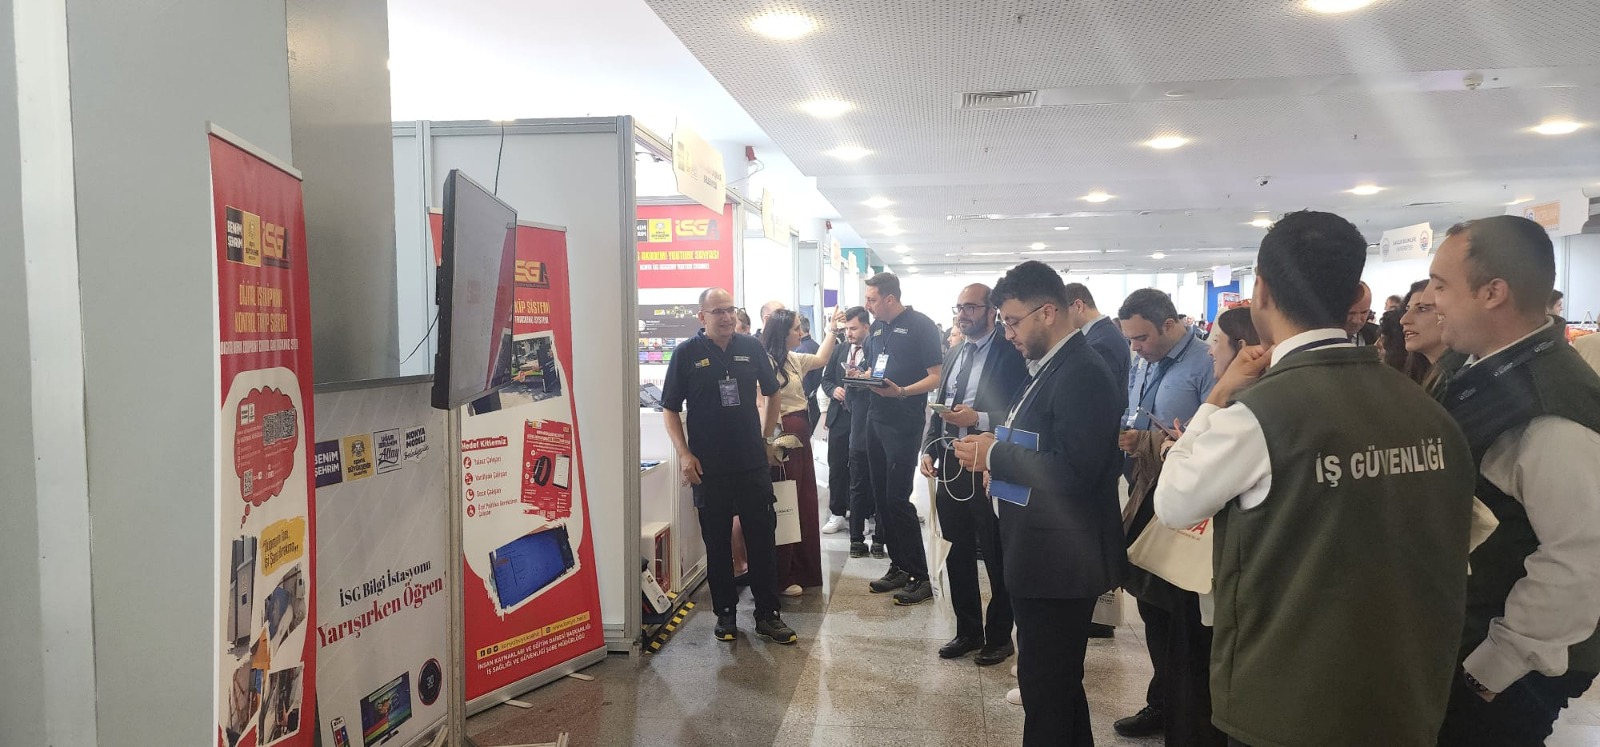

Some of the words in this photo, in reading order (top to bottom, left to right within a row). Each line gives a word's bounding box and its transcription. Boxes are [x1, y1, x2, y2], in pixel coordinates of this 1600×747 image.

[405, 428, 425, 441] KONYA
[315, 451, 339, 465] BENİM
[1315, 452, 1343, 488] İŞ
[1350, 437, 1445, 480] GÜVENLİĞİ
[315, 464, 340, 478] ŞEHRİM
[339, 586, 361, 608] İSG
[363, 575, 385, 598] Bilgi
[387, 560, 431, 588] İstasyonu
[317, 596, 401, 649] Yarışırken
[403, 577, 443, 610] Öğren
[492, 661, 512, 673] SAĞLIĞI
[512, 658, 519, 666] VE
[520, 648, 546, 663] GÜVENLİĞİ
[494, 649, 525, 664] KAYNAKLARI
[525, 645, 532, 654] VE
